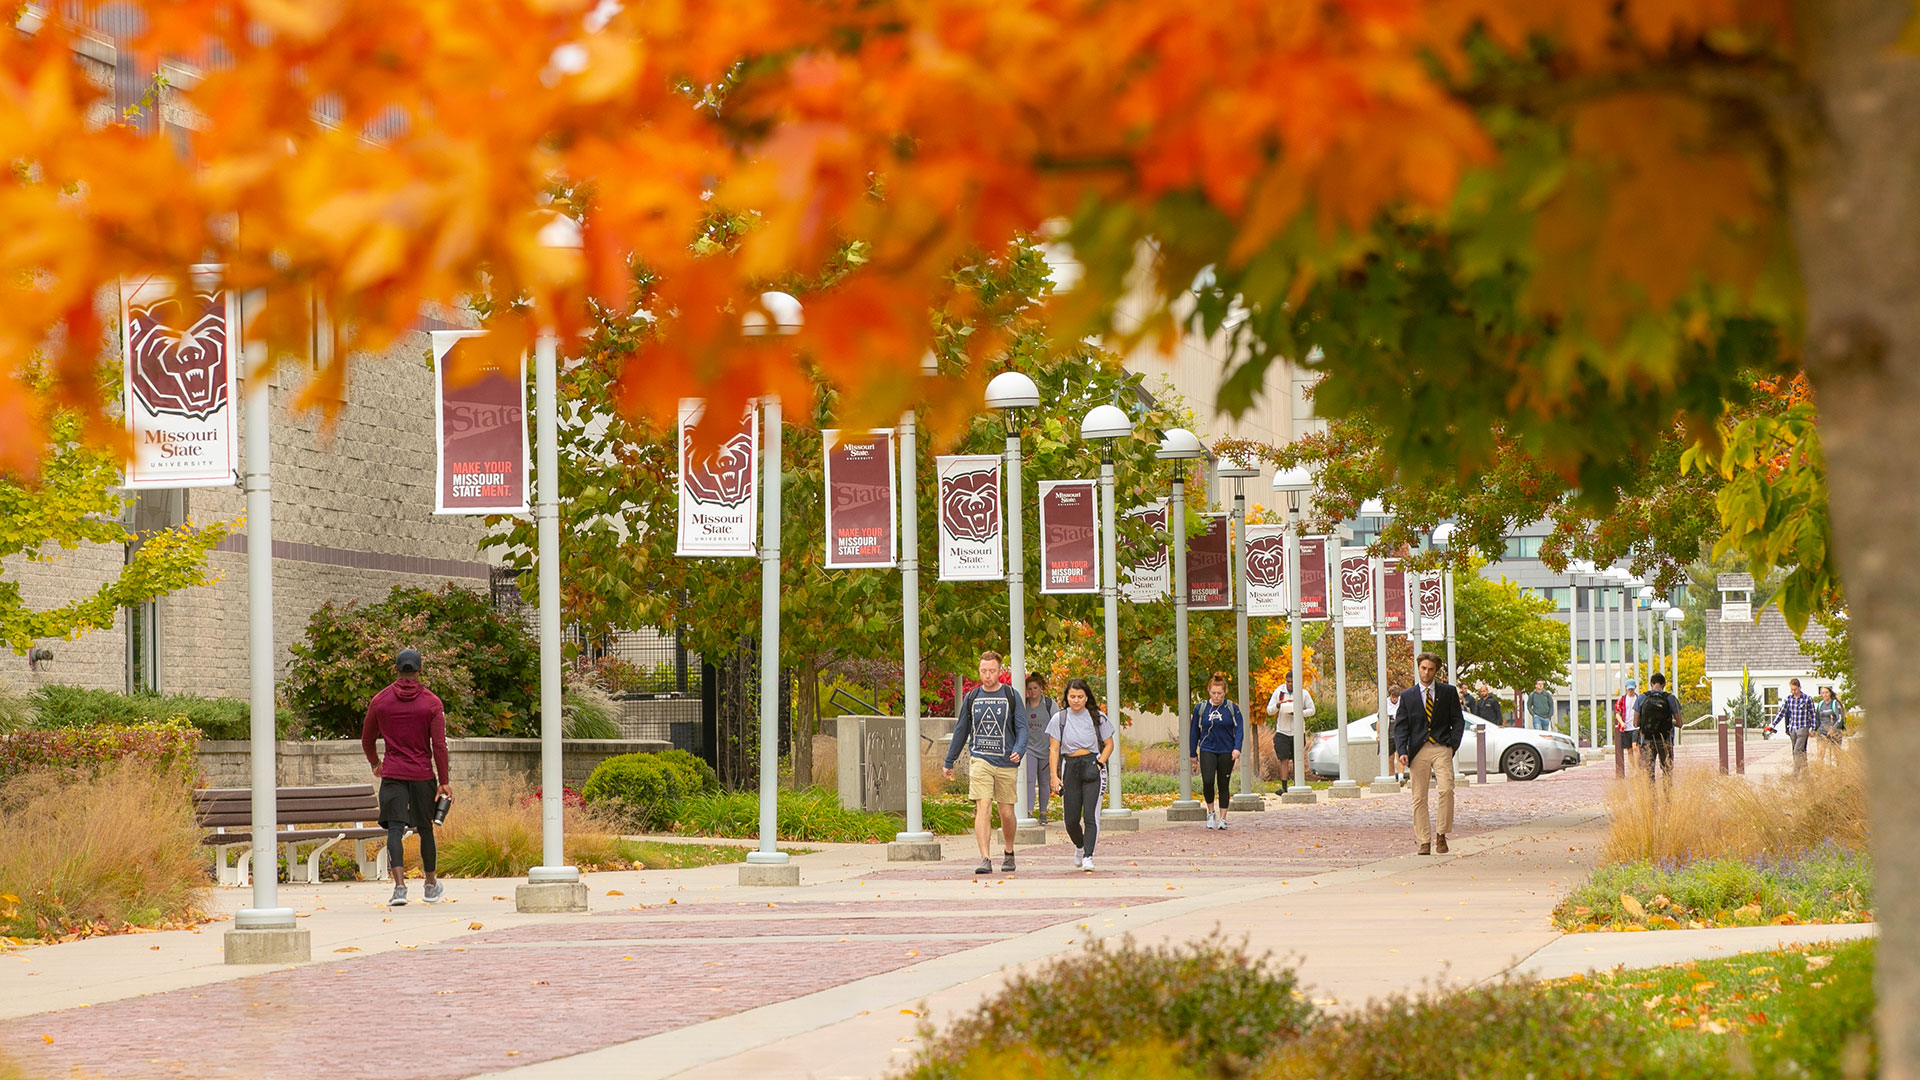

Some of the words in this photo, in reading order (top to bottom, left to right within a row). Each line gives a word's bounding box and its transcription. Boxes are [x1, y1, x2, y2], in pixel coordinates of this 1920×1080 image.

[451, 405, 522, 432] State
[144, 428, 218, 444] Missouri
[161, 443, 203, 459] State
[843, 443, 875, 451] Missouri
[150, 460, 214, 468] UNIVERSITY
[453, 462, 481, 474] MAKE
[484, 461, 512, 473] YOUR
[453, 473, 504, 486] MISSOURI
[452, 484, 512, 498] STATEMENT.
[837, 485, 890, 506] State
[692, 513, 744, 525] Missouri
[702, 524, 732, 535] State
[838, 528, 860, 537] MAKE
[861, 527, 883, 537] YOUR
[1051, 526, 1094, 544] State
[838, 536, 877, 546] MISSOURI
[950, 547, 992, 557] Missouri
[959, 555, 984, 564] State
[1070, 560, 1088, 568] YOUR
[1051, 568, 1083, 576] MISSOURI
